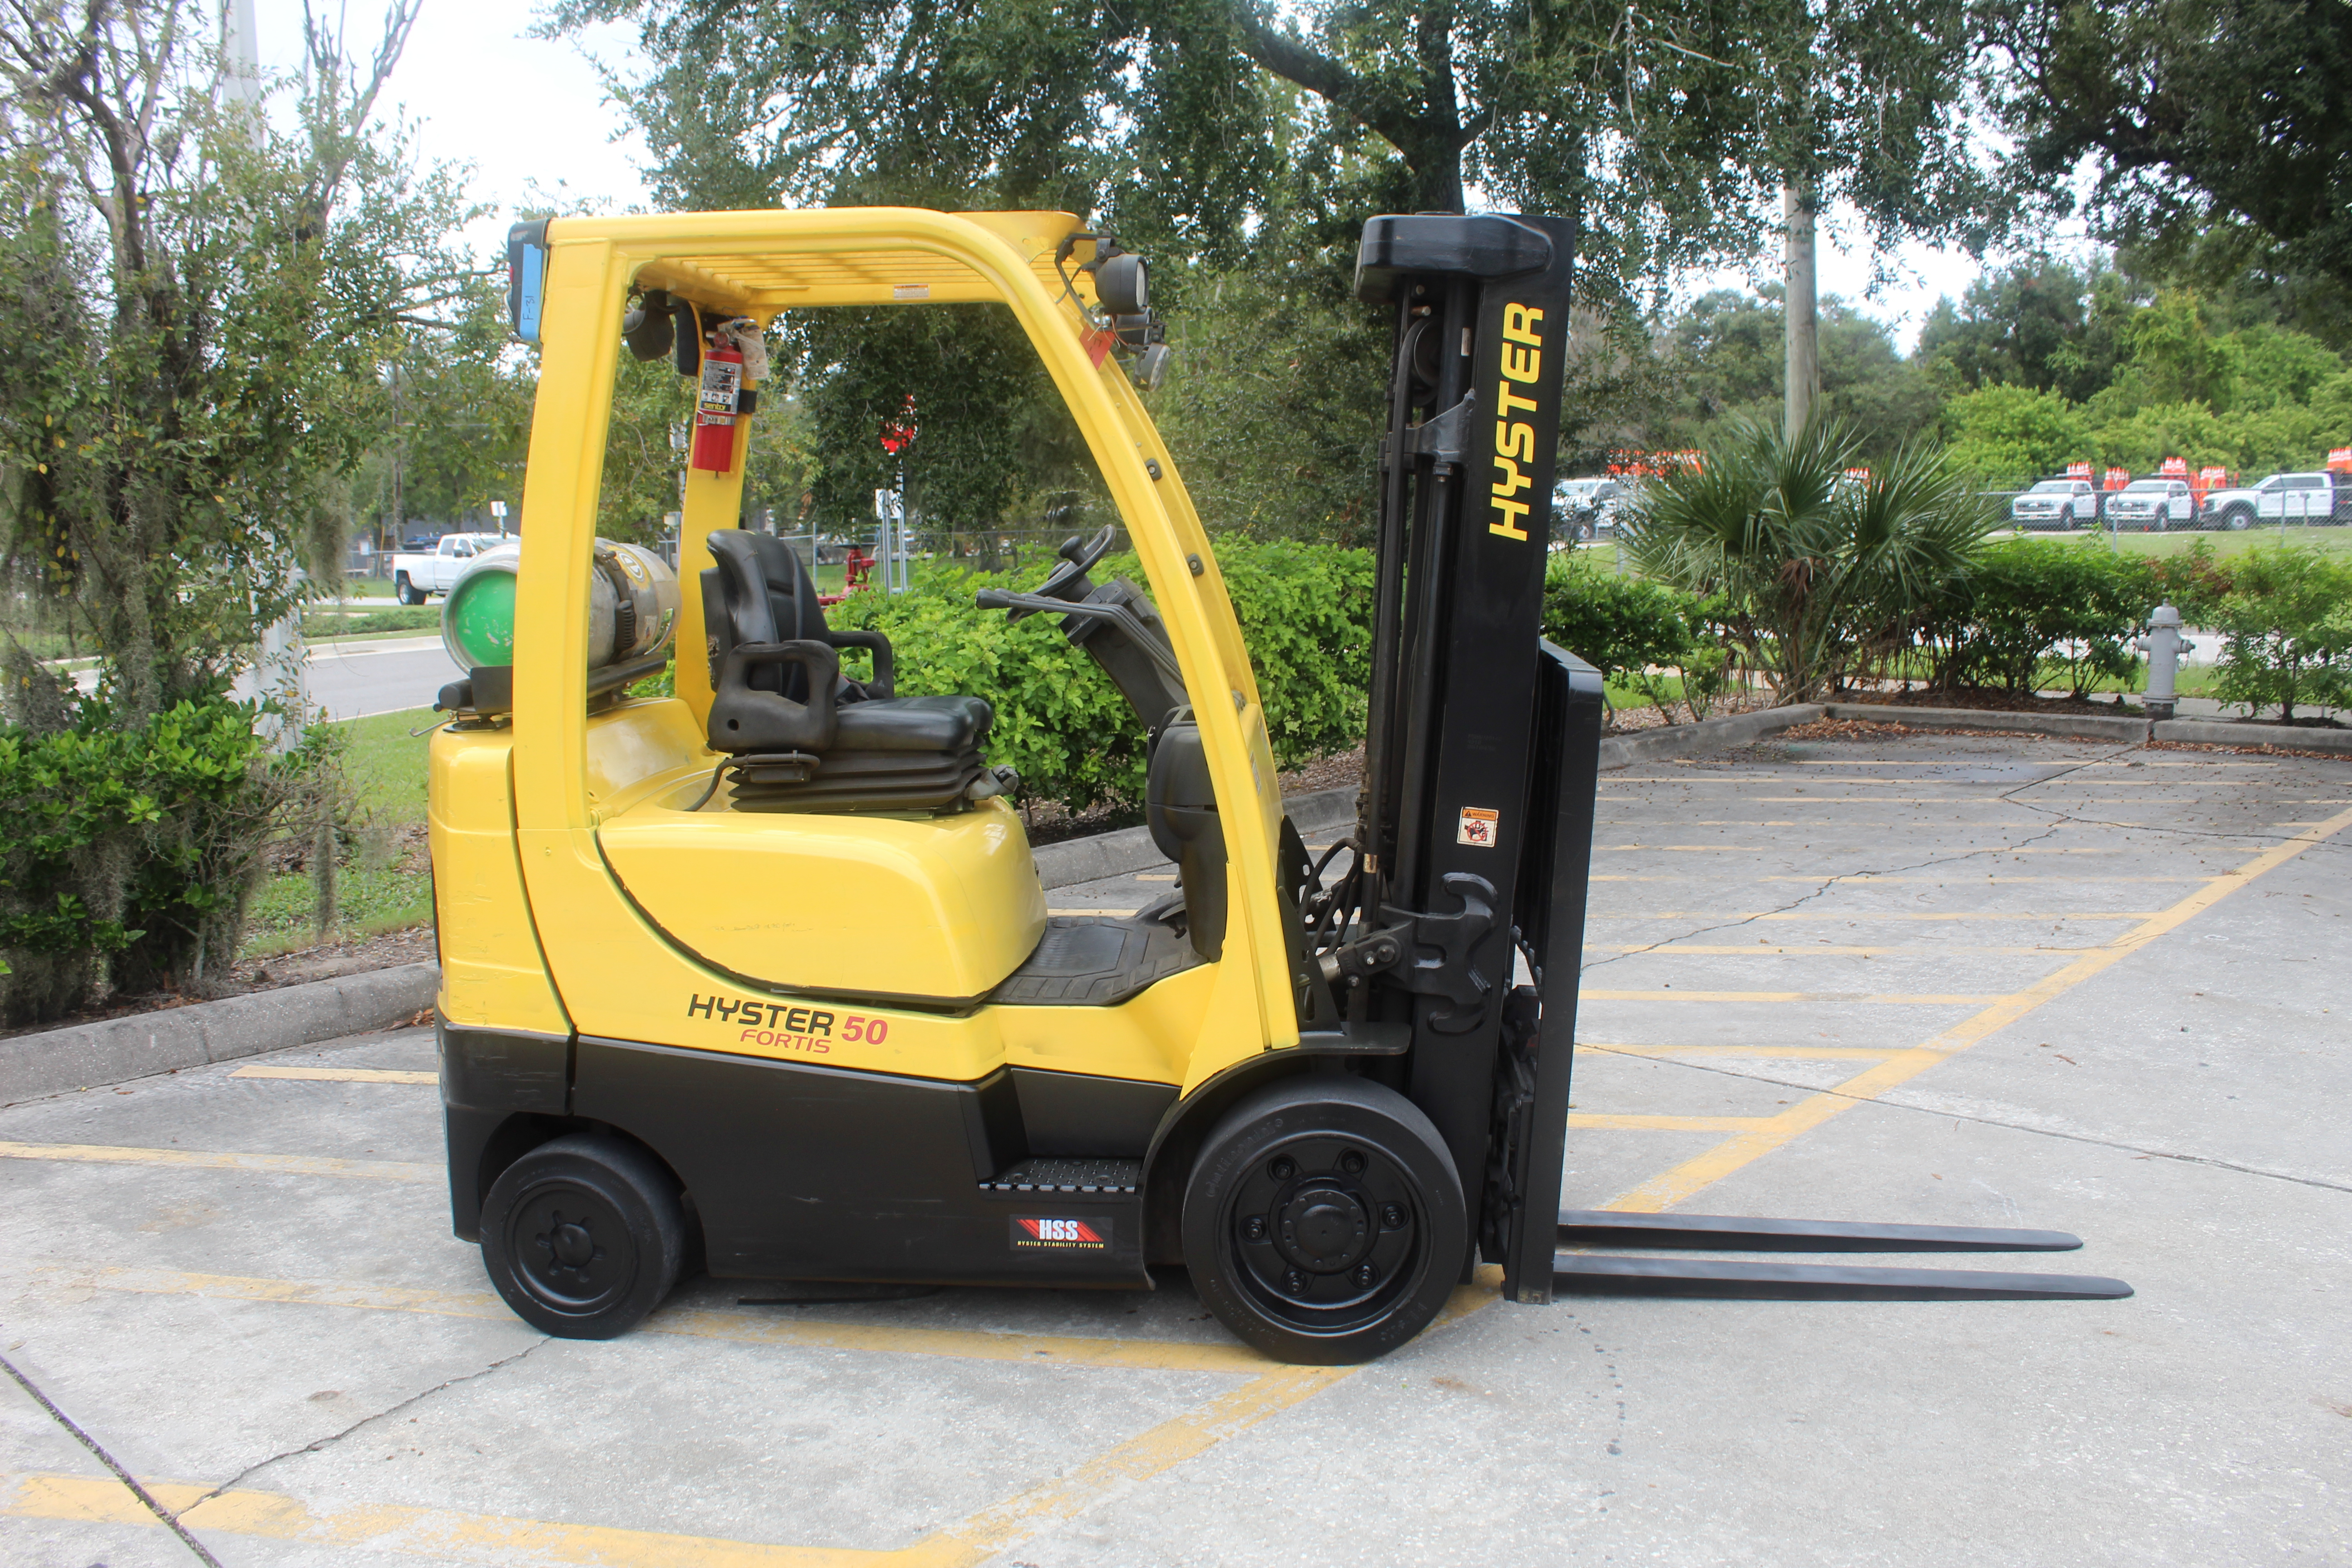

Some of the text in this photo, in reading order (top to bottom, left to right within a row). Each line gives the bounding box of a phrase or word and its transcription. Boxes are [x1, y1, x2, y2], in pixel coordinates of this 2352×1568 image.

[704, 402, 726, 411] sentry
[1489, 302, 1544, 542] HYSTER
[687, 994, 888, 1045] HYSTER 50
[740, 1029, 832, 1054] FORTIS
[1039, 1219, 1078, 1240] HSS
